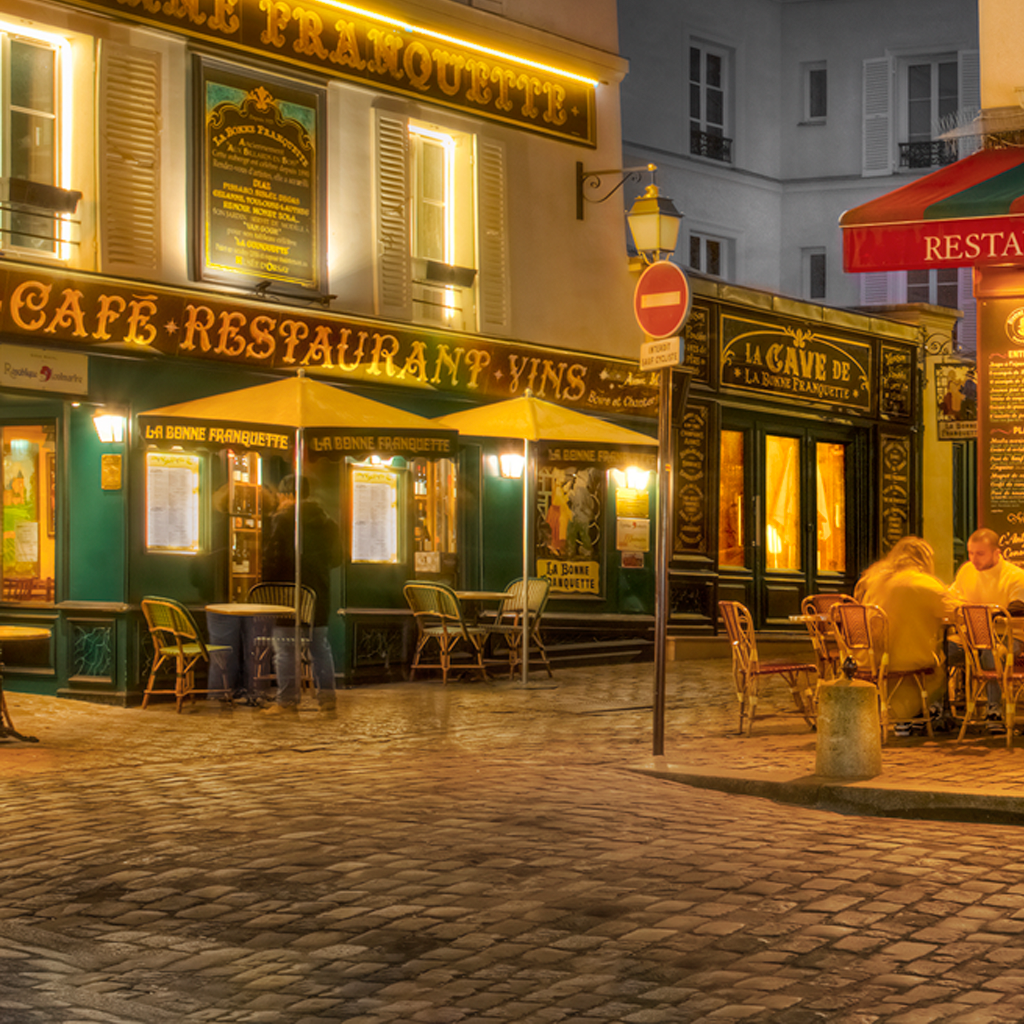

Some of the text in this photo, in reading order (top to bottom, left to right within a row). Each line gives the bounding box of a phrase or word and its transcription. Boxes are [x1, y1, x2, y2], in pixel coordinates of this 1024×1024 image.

[10, 280, 587, 401] CAFÉ RESTAURANT VINS
[745, 342, 851, 382] LA CAVE DE
[744, 368, 850, 399] LA BONNE FRANQUETTE
[146, 425, 288, 450] LA BONNE FRANQUETTE
[314, 436, 450, 453] LA BONNE FRANQUETTE
[549, 449, 561, 461] LA
[563, 449, 595, 462] BONNE
[546, 561, 590, 576] LA BONNE
[547, 577, 596, 590] RANQUETTE
